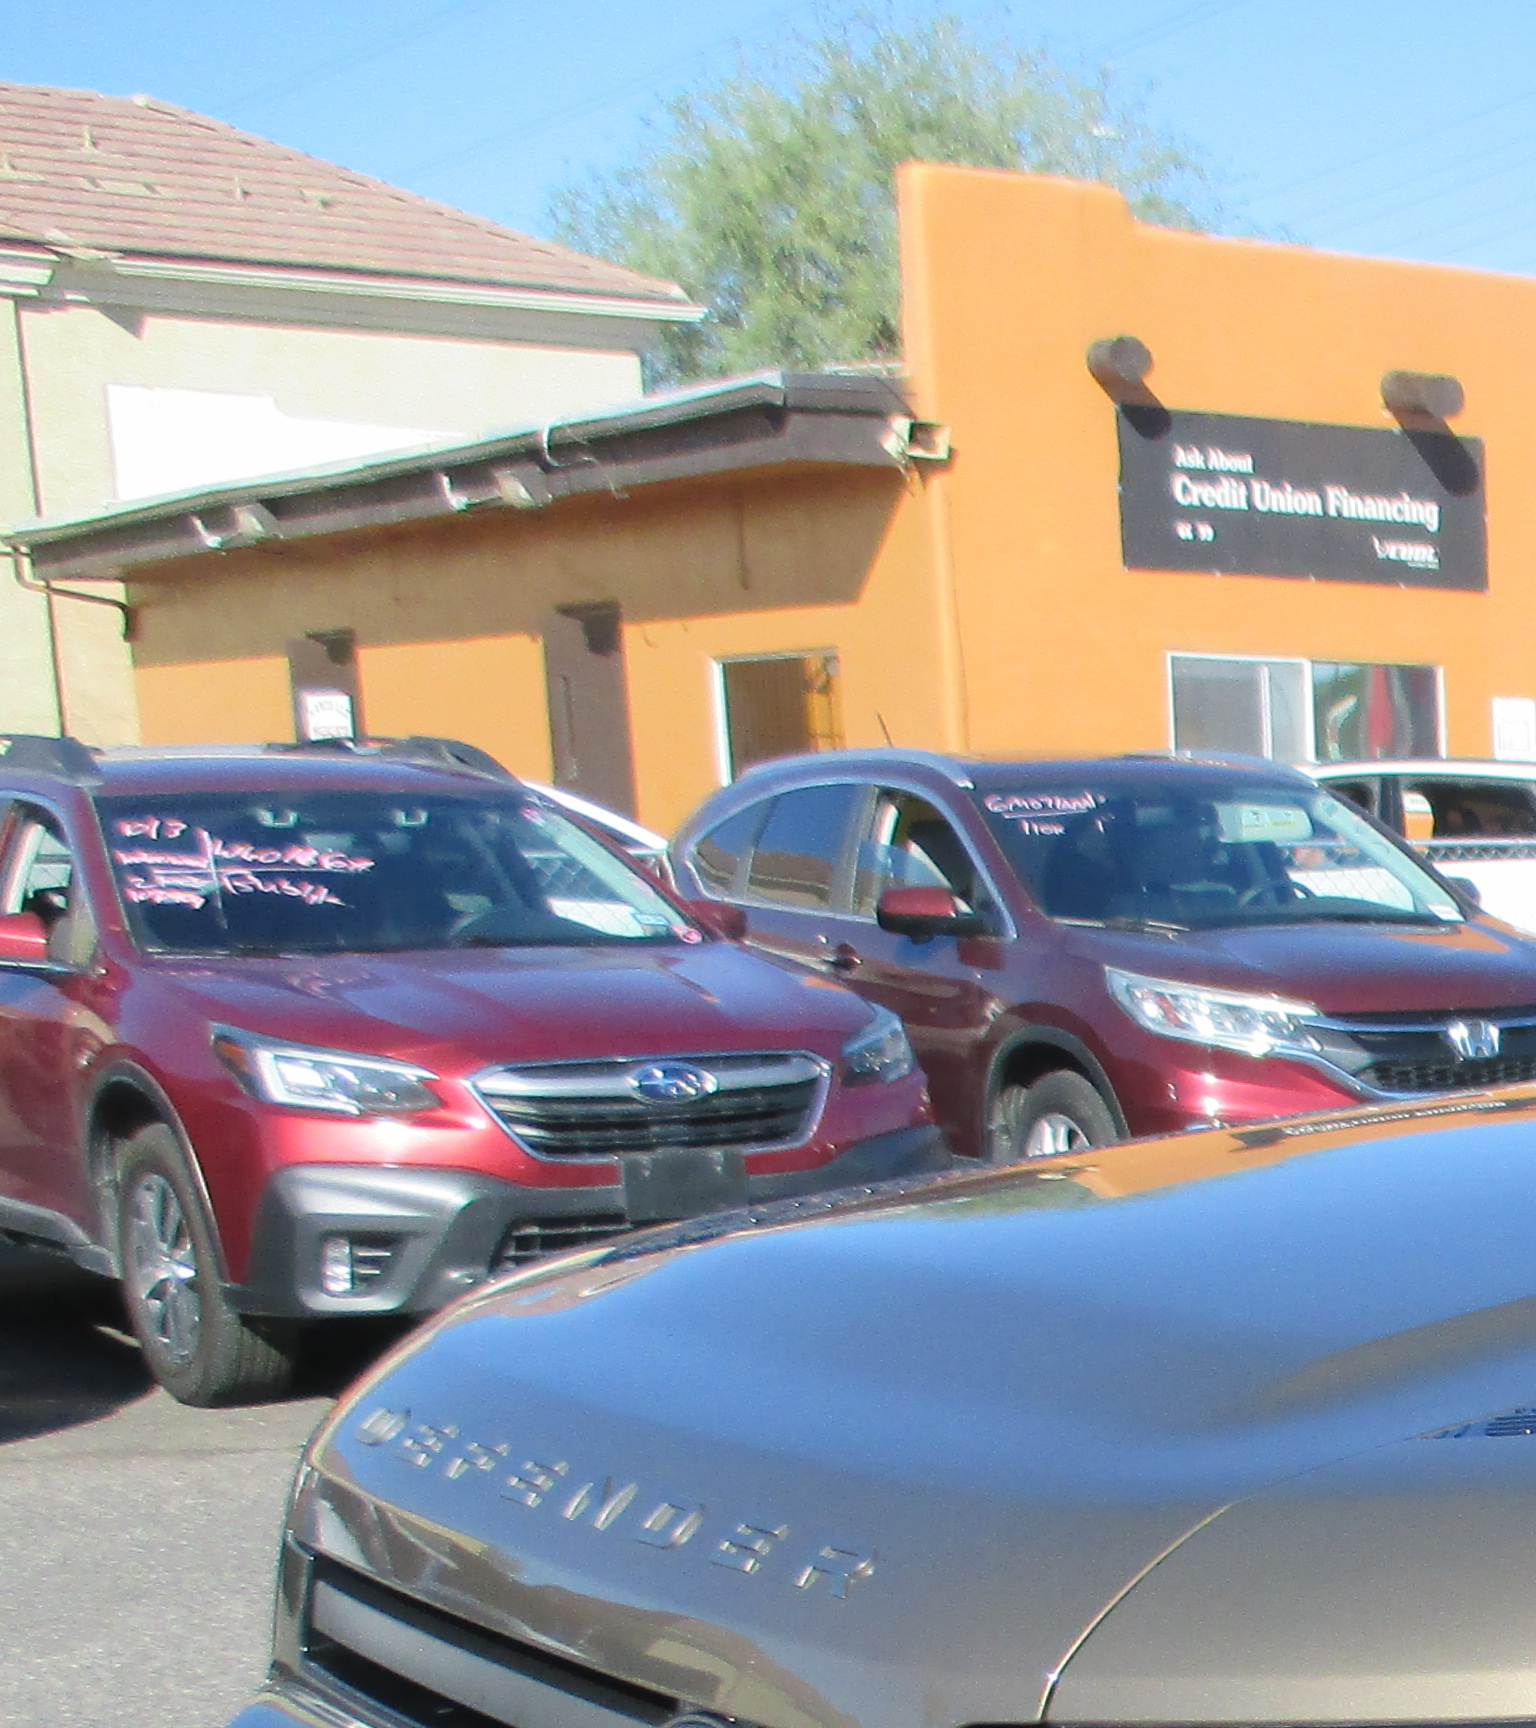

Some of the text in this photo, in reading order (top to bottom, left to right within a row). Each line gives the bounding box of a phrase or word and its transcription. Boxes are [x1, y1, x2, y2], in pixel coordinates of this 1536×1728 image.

[1173, 444, 1255, 474] Ask About
[1171, 472, 1440, 533] Credit Union Financing
[354, 1406, 881, 1600] DEFENDER
